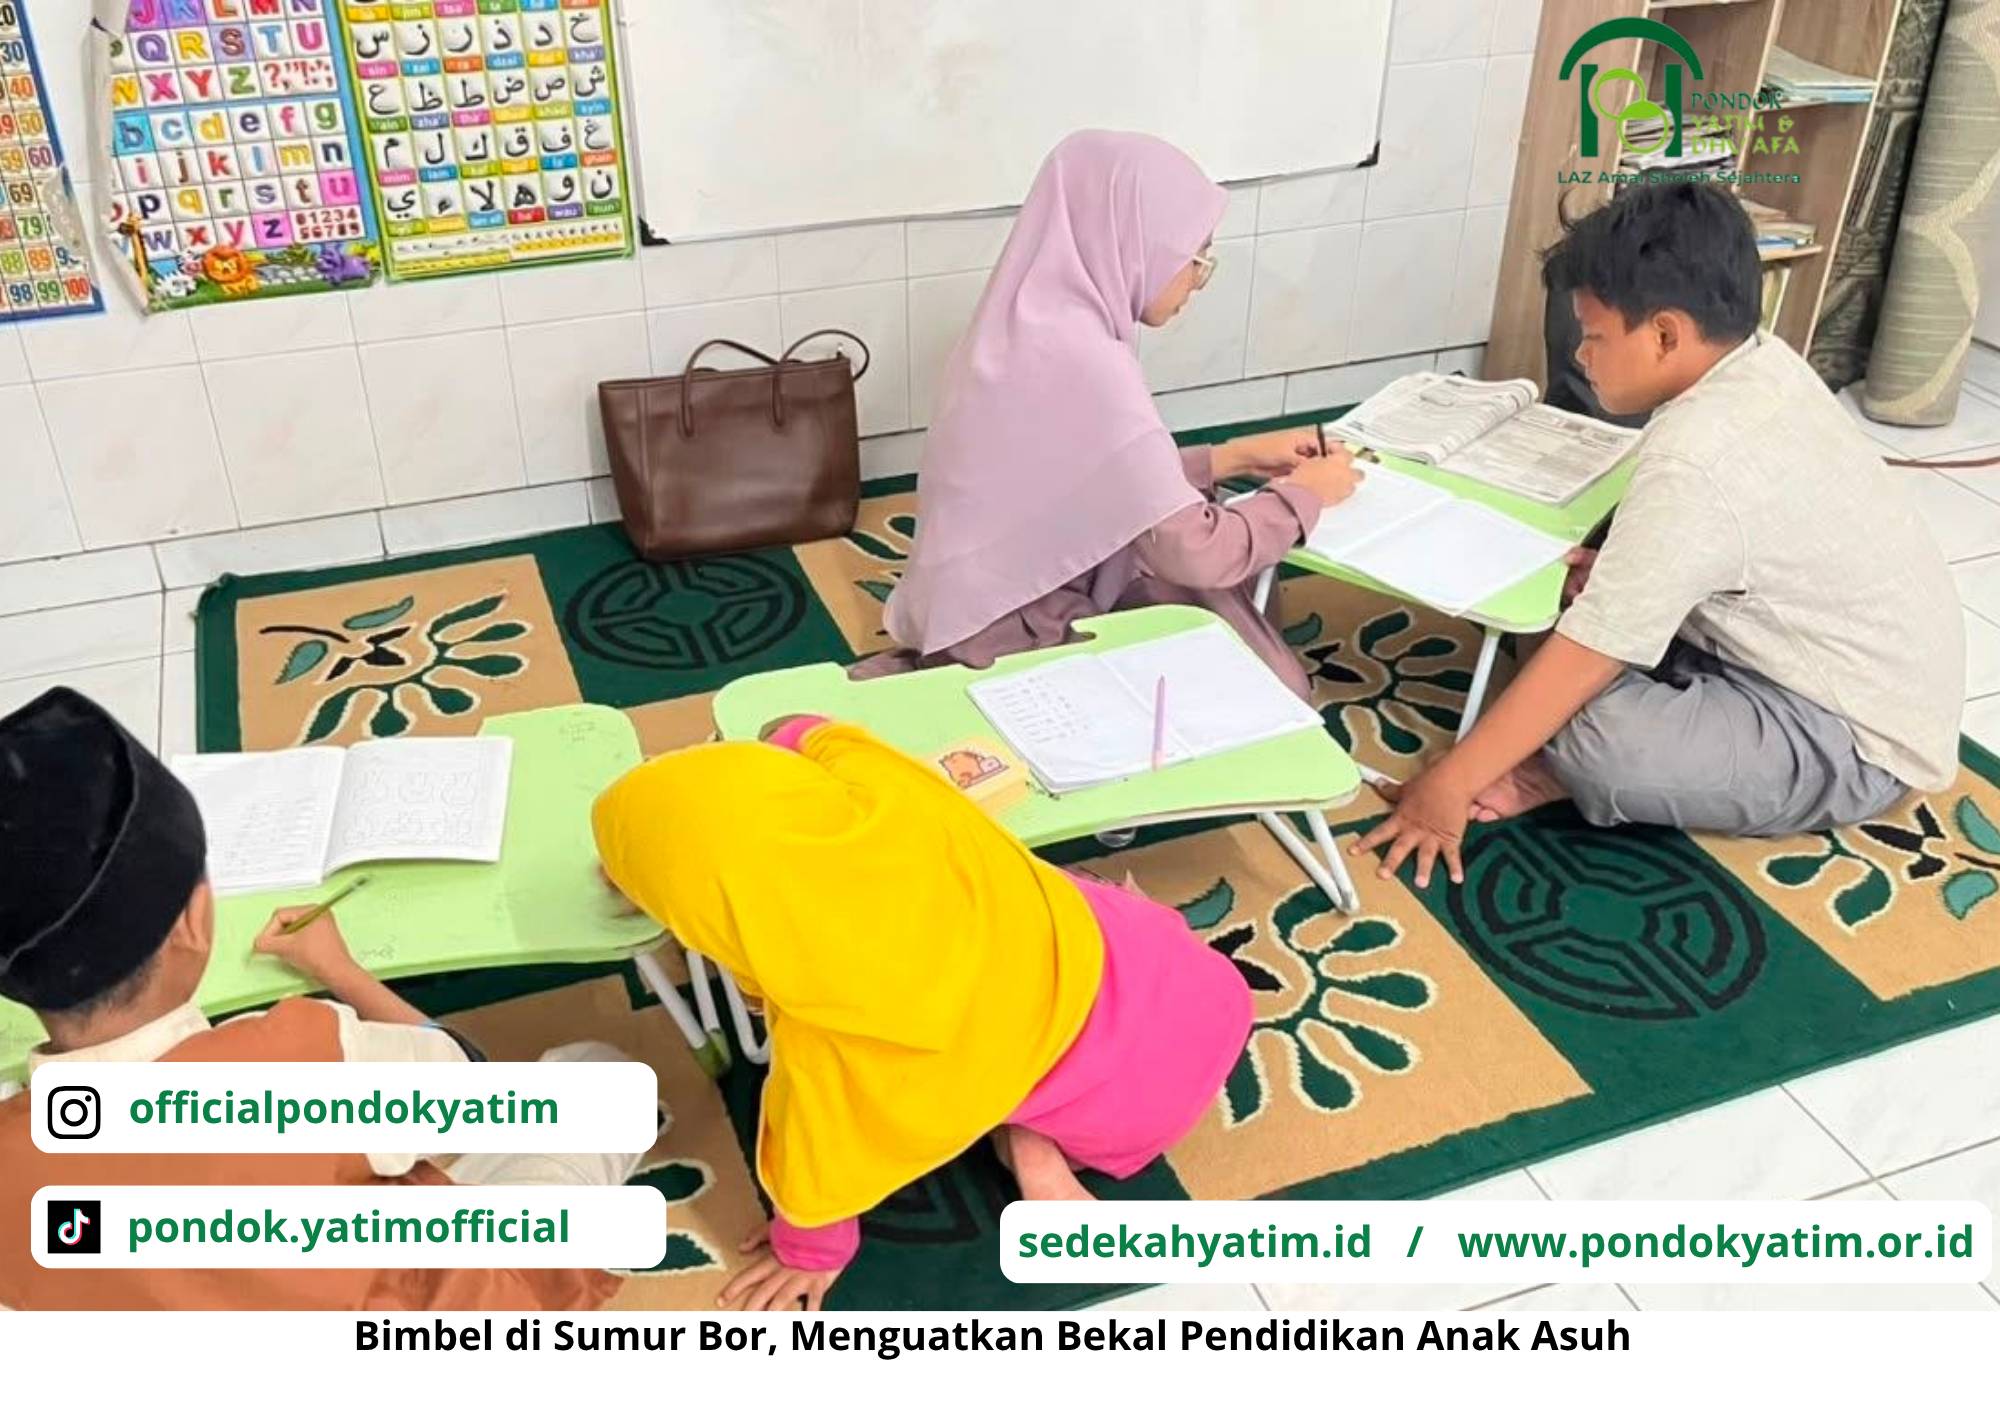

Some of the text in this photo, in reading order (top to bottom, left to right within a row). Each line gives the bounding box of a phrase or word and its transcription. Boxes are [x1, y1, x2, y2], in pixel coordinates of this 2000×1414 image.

[132, 0, 155, 24] J
[137, 33, 170, 62] Q
[176, 31, 209, 60] R
[219, 28, 246, 56] S
[257, 24, 283, 53] T
[296, 21, 323, 50] U
[356, 13, 600, 58] خ د ذ ر ز س
[145, 72, 178, 102] X
[185, 69, 213, 98] Y
[228, 66, 256, 95] Z
[368, 65, 605, 115] ش ص ض ط ظ ع
[119, 101, 338, 148] b c d e f g
[28, 145, 52, 168] 60
[384, 118, 610, 168] غ ف ق ك ل م
[135, 157, 148, 184] i
[176, 151, 189, 183] j
[207, 150, 231, 176] k
[278, 144, 311, 166] m
[321, 142, 344, 162] n
[8, 182, 33, 203] 69
[137, 193, 161, 219] p
[178, 189, 204, 214] q
[219, 188, 233, 208] r
[255, 184, 276, 204] s
[295, 178, 311, 203] t
[329, 177, 351, 197] u
[469, 180, 494, 211] لا
[552, 175, 574, 201] و
[591, 169, 613, 199] ن
[387, 190, 415, 219] ي
[17, 216, 42, 239] 79
[143, 229, 172, 251] w
[185, 225, 209, 246] x
[224, 220, 244, 247] y
[263, 218, 283, 239] z
[56, 246, 80, 265] 9
[9, 277, 90, 303] 98 99 100
